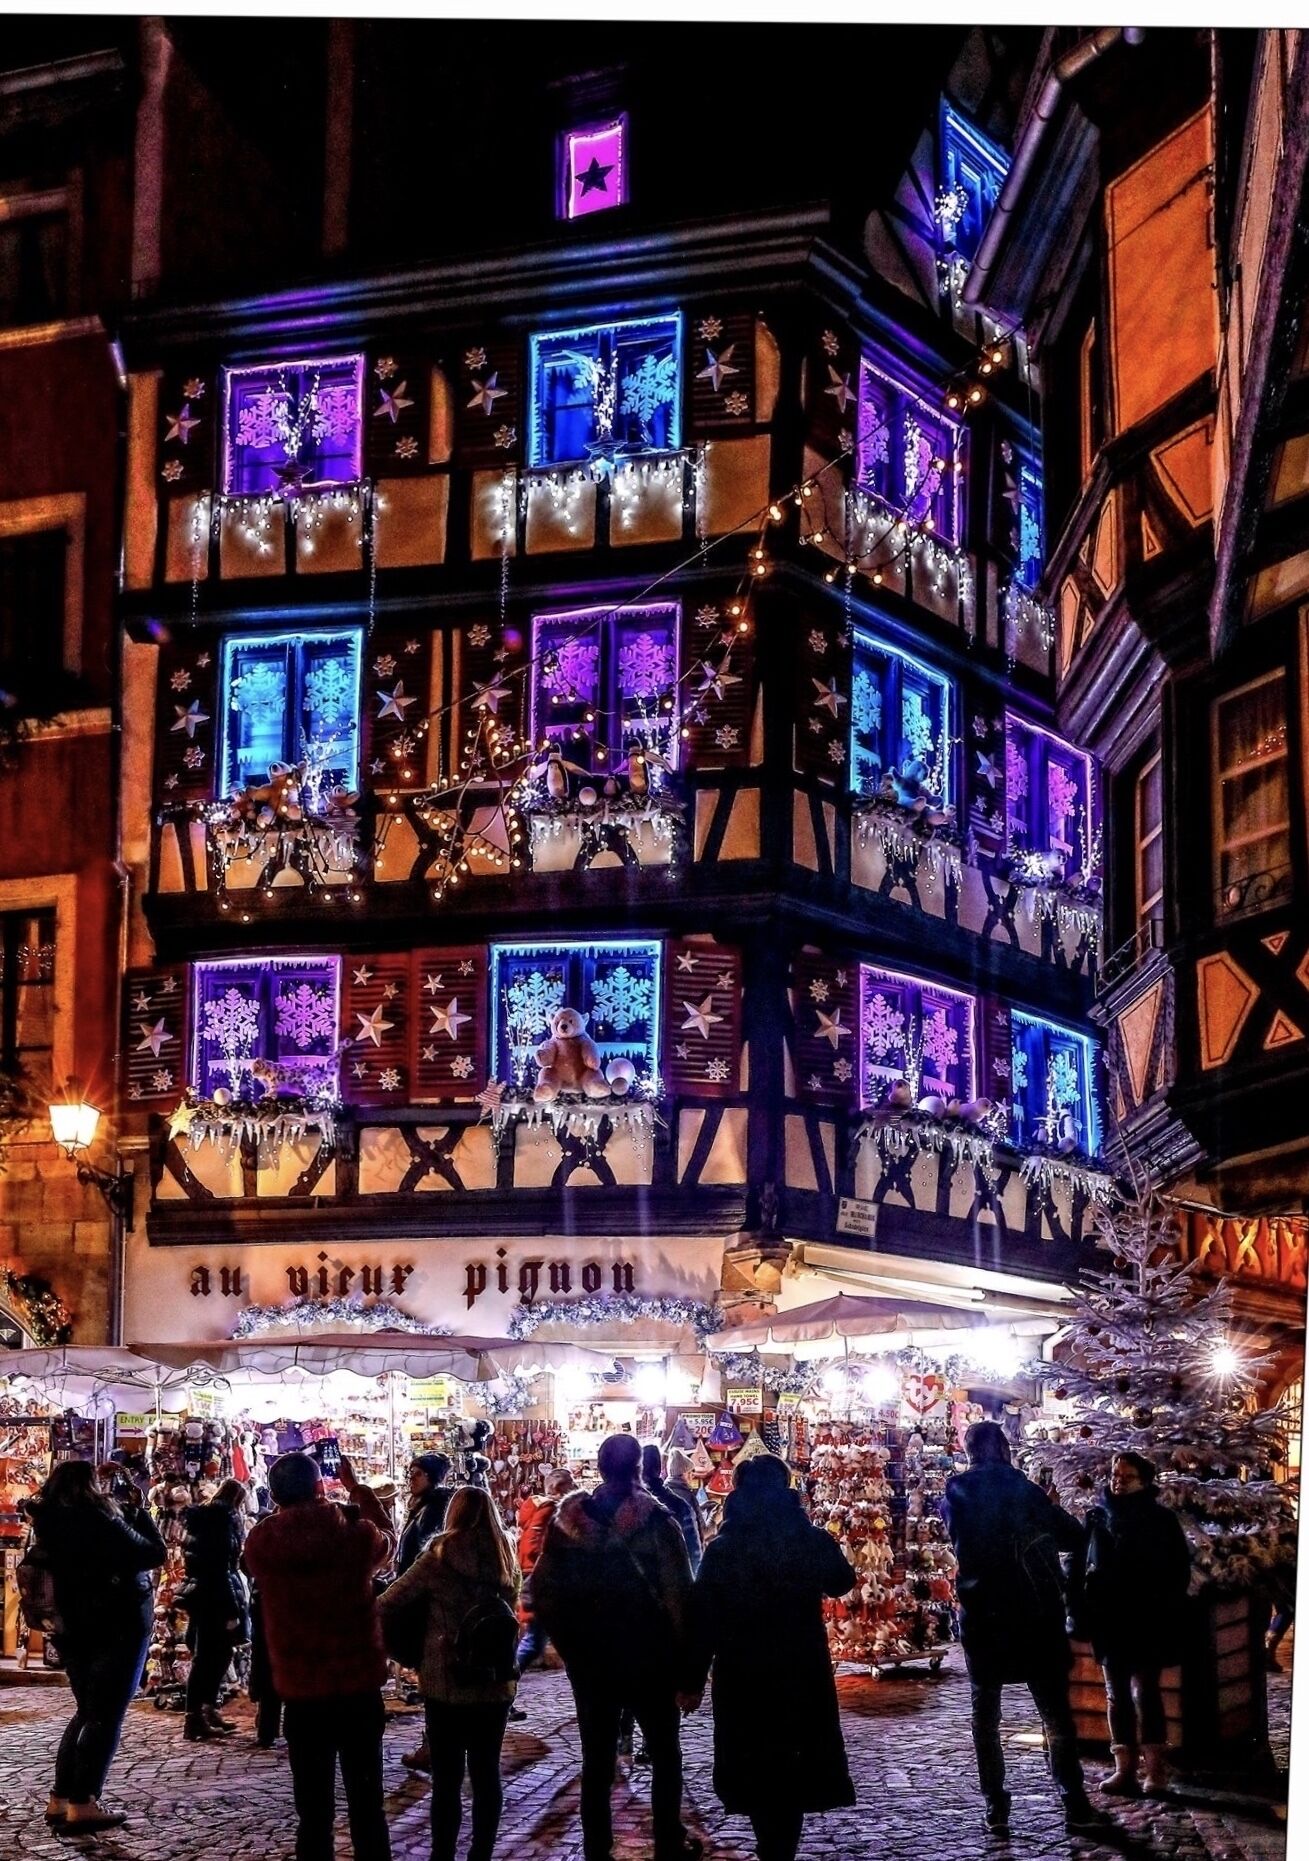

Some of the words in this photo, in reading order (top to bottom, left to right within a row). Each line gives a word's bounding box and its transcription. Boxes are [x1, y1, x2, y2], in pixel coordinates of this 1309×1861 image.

[189, 1265, 244, 1297] au
[463, 1246, 636, 1311] pignon
[120, 1416, 145, 1424] ENTRY
